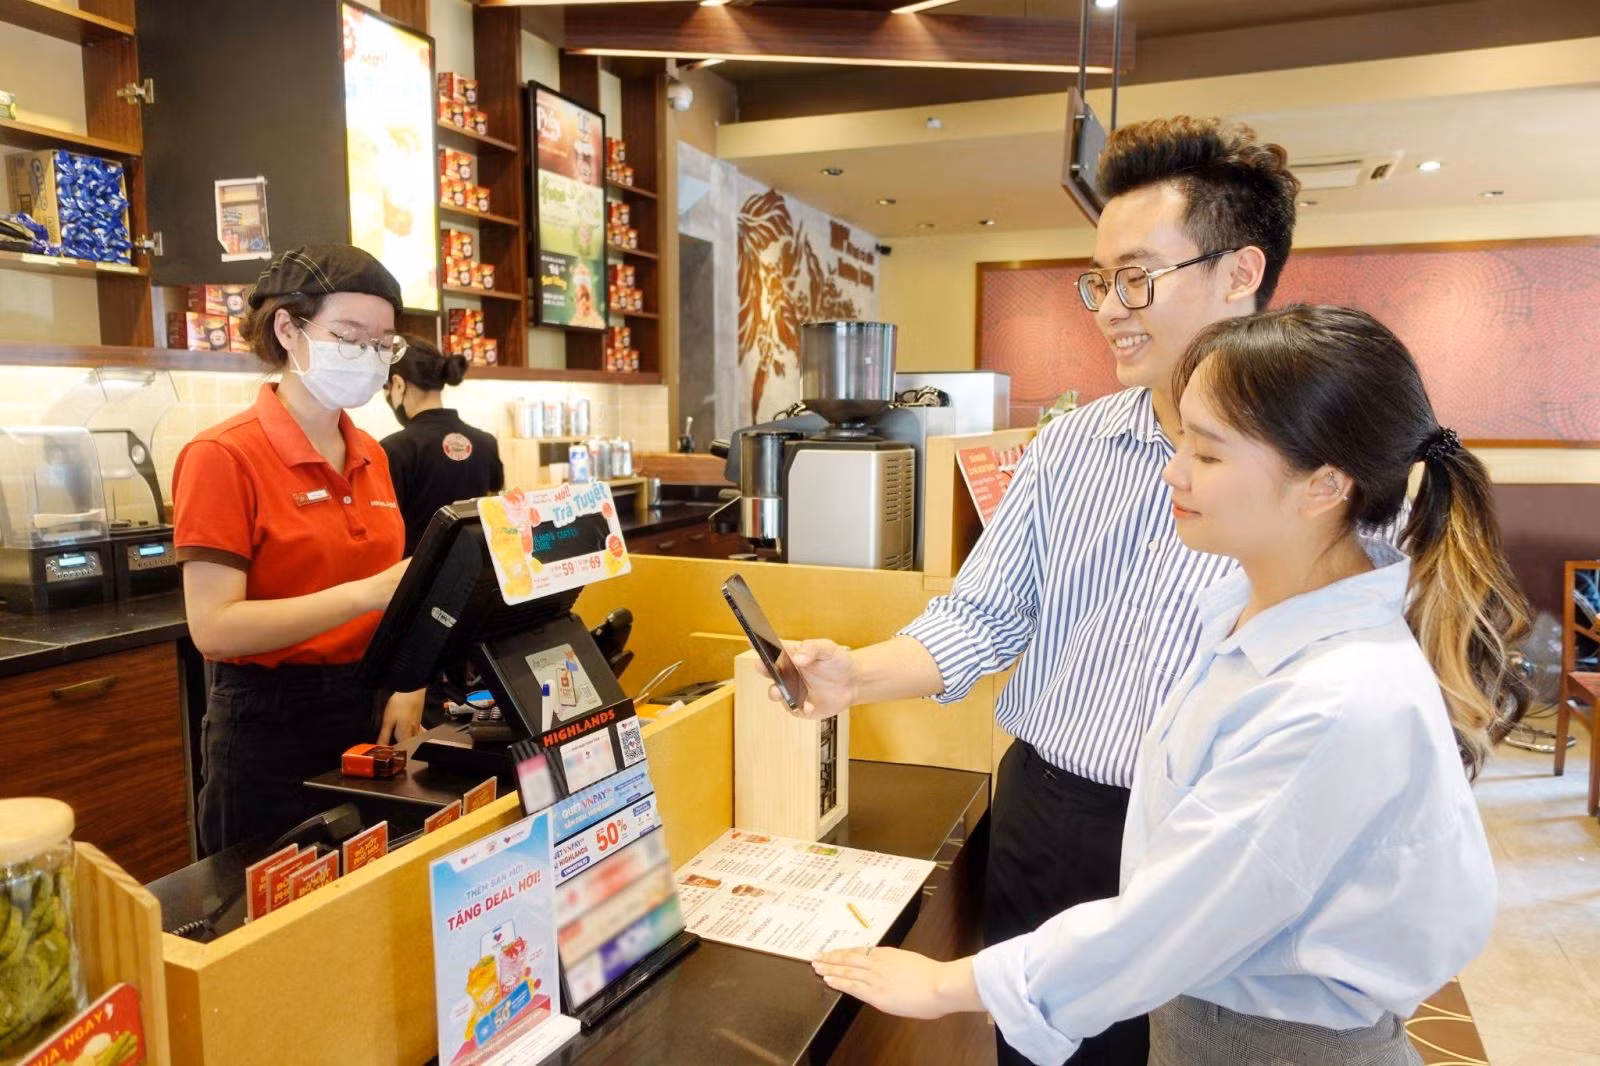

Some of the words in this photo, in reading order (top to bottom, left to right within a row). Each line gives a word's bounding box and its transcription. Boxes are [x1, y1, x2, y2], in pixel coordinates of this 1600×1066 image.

[562, 562, 575, 576] 59
[589, 555, 601, 569] 69
[543, 709, 616, 747] HIGHLANDS
[595, 817, 628, 852] 50%
[485, 886, 515, 911] DEAL
[64, 1011, 104, 1051] NGAY
